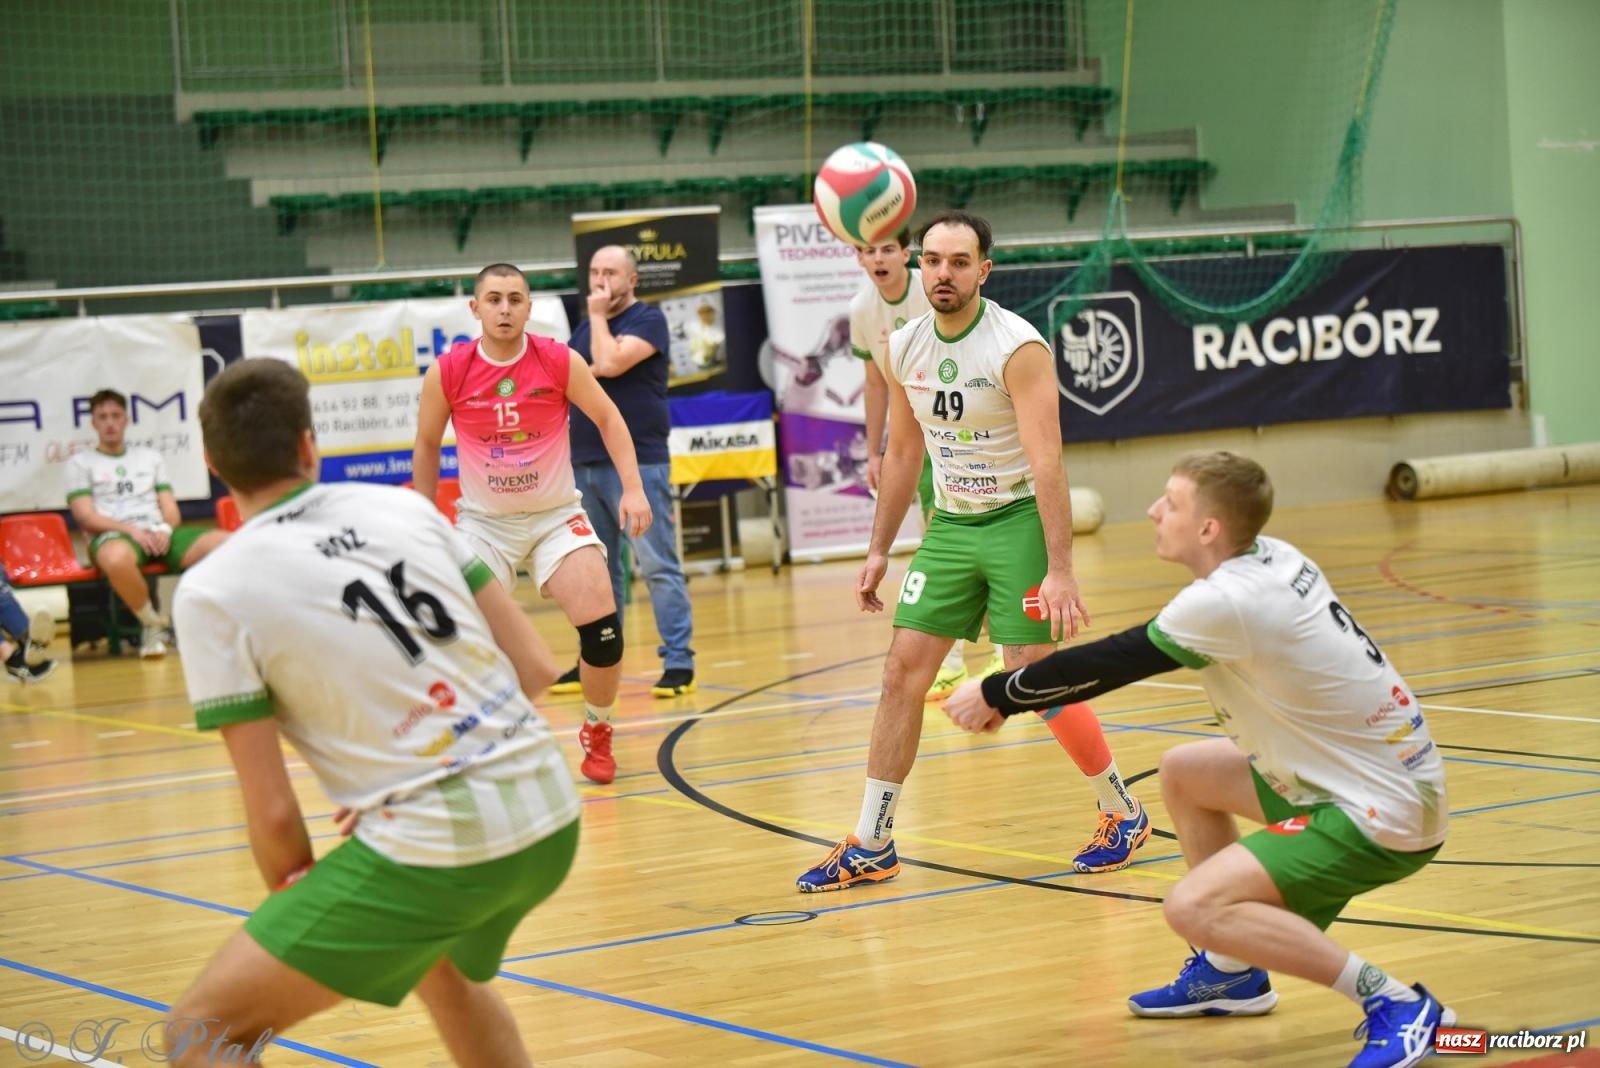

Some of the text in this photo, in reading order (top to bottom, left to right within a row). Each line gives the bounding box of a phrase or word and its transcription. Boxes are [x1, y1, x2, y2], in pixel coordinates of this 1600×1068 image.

[775, 223, 836, 244] PIVE
[1193, 297, 1442, 371] RACIBÓRZ
[492, 401, 520, 427] 15
[932, 391, 964, 421] 49
[487, 471, 539, 487] PIVEXIN
[341, 559, 457, 667] 16
[1329, 601, 1383, 667] 3
